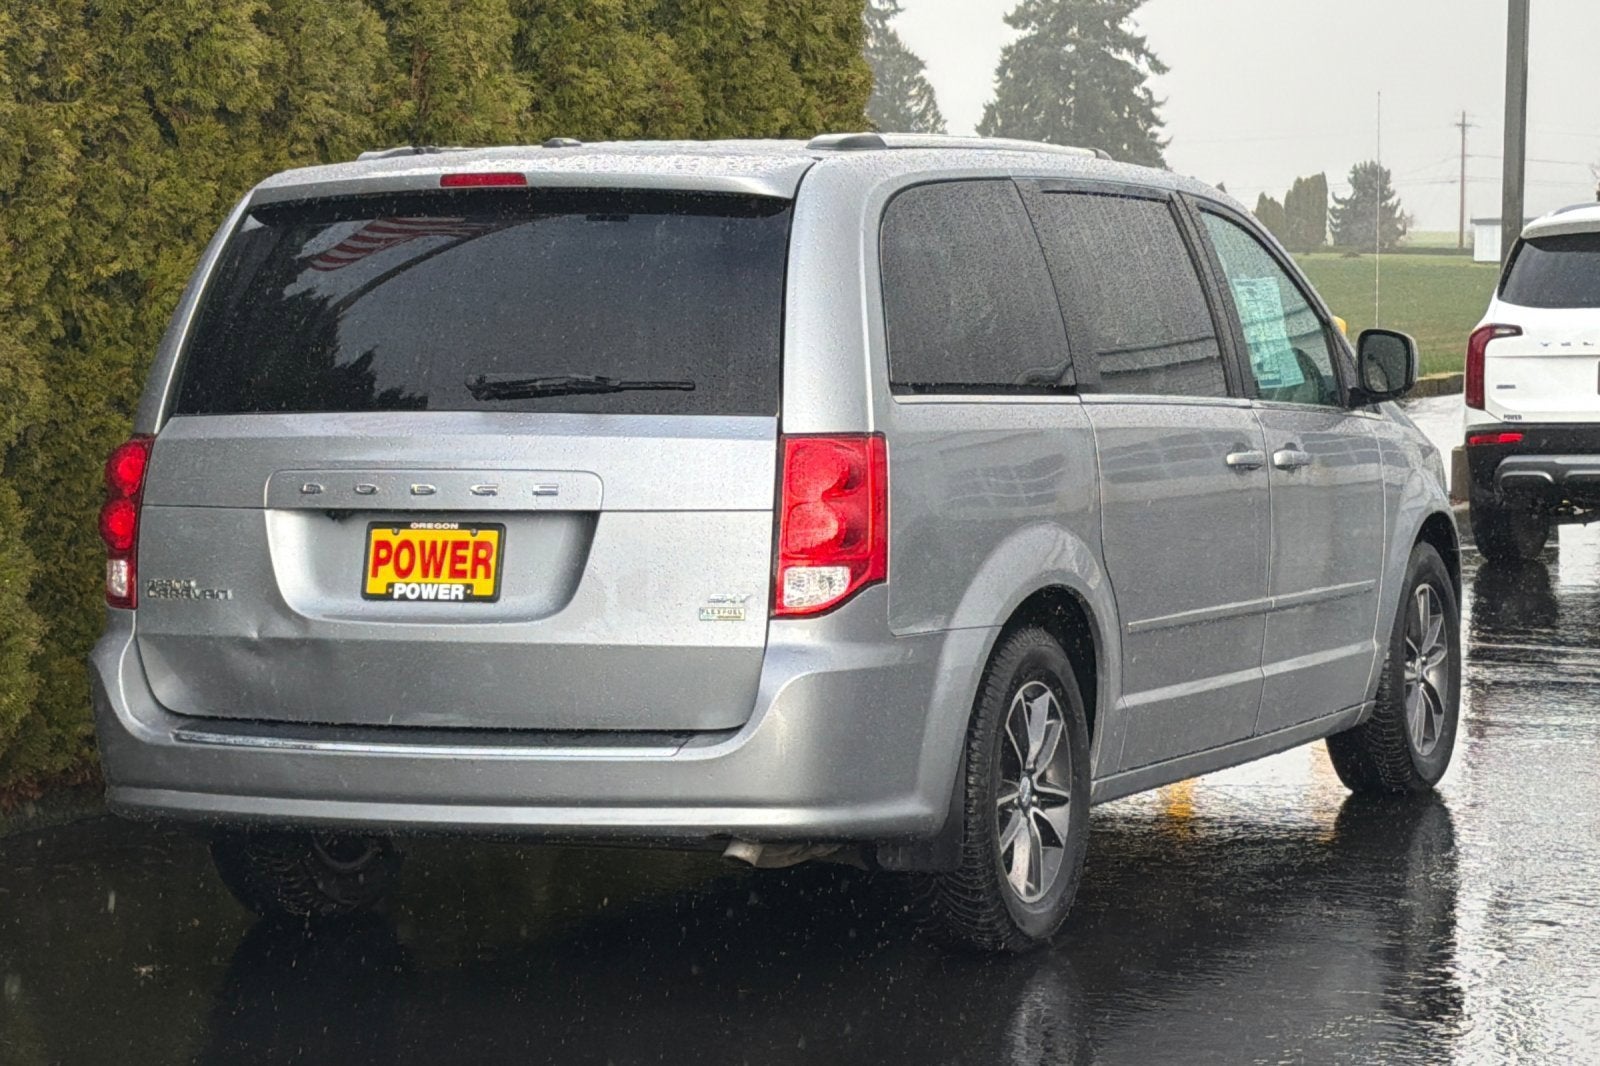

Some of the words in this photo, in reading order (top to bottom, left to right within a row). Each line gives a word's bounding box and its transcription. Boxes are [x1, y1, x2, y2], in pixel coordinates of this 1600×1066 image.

[301, 483, 560, 496] DODGE
[410, 522, 459, 530] OREGON
[371, 539, 494, 580] POWER
[393, 583, 465, 600] POWER
